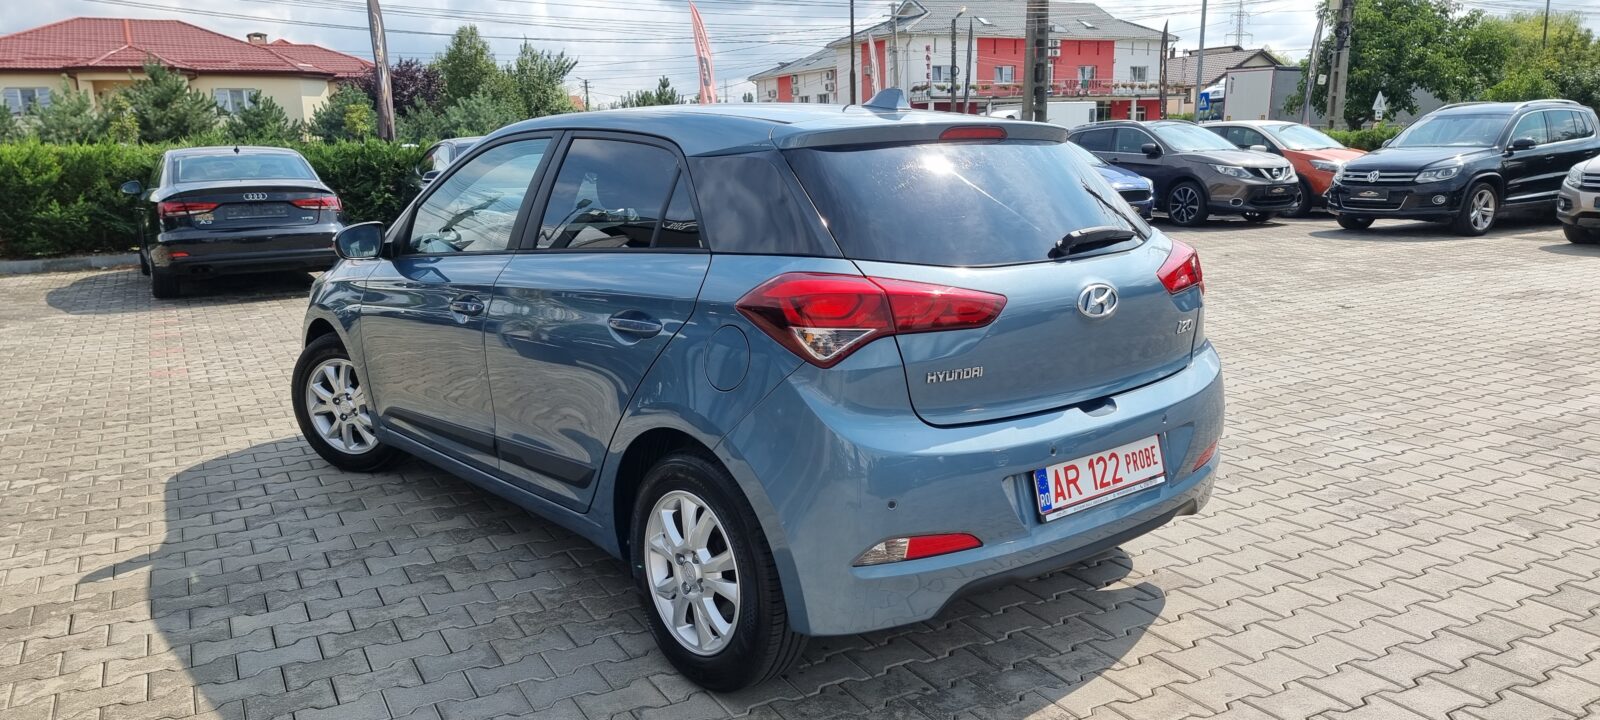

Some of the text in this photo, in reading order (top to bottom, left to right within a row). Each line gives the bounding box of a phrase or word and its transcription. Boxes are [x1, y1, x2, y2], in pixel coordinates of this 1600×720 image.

[1176, 319, 1193, 334] i20
[927, 366, 983, 384] HYUNDAI
[1054, 445, 1158, 503] AR 122 PROBE
[1040, 493, 1051, 508] RO
